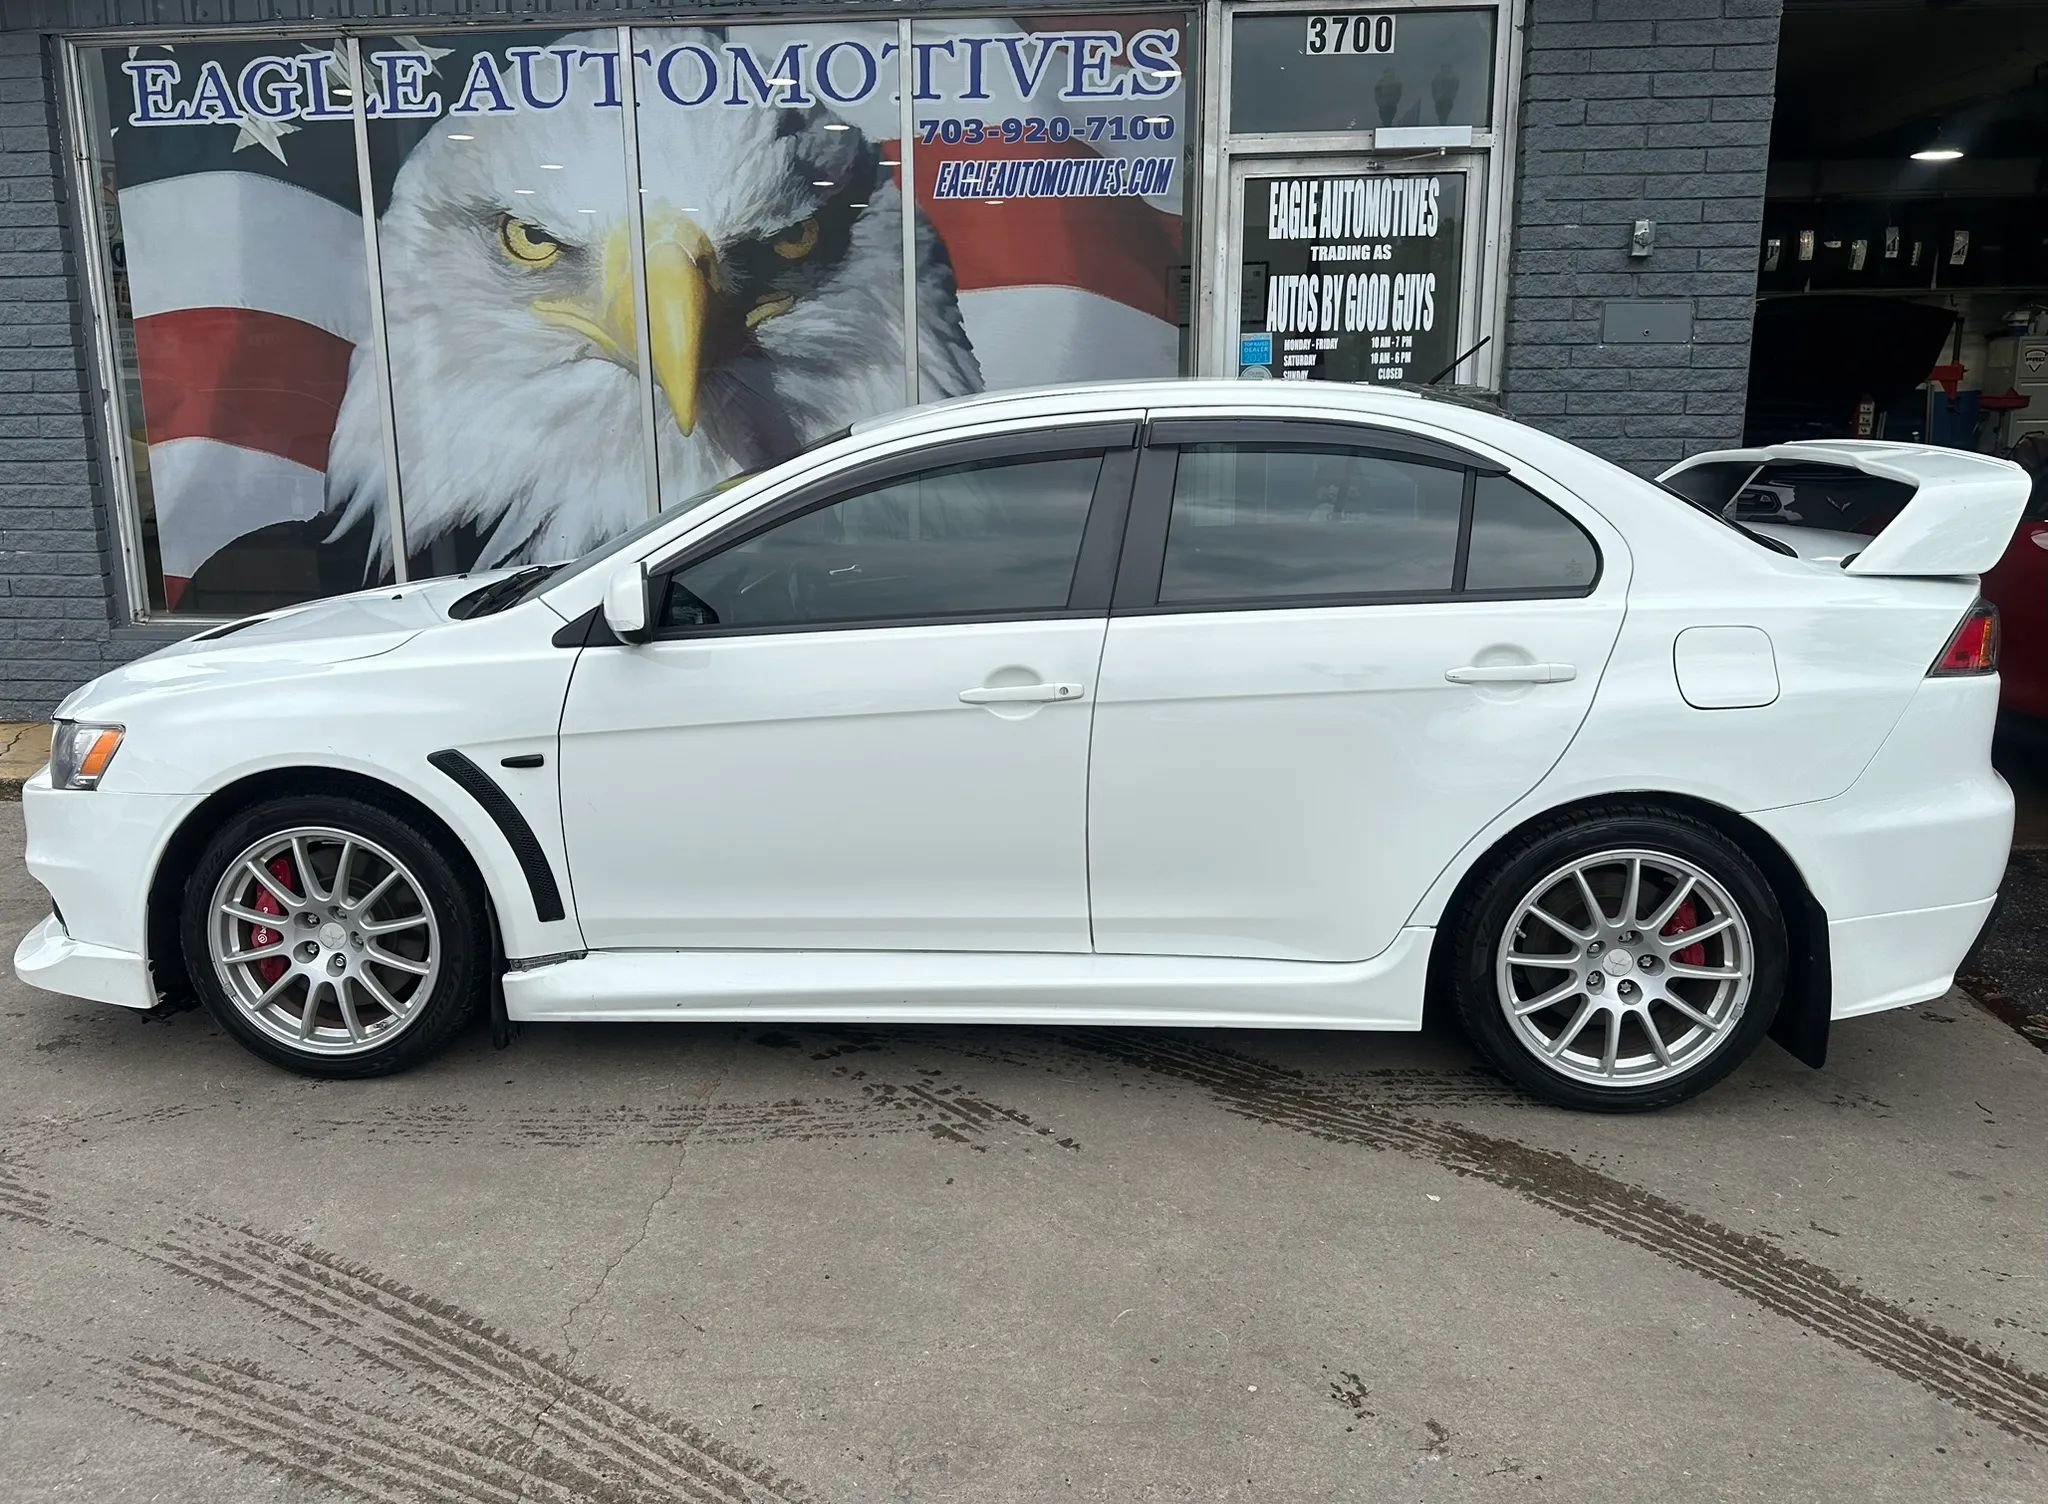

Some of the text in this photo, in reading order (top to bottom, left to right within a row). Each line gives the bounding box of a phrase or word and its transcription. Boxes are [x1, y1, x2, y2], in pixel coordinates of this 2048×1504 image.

[1309, 15, 1393, 54] 3700
[123, 31, 1181, 125] EAGLE AUTOMOTIVES
[919, 116, 1175, 144] 703-920-7100
[933, 157, 1175, 199] EAGLEAUTOMOTIVES.COM
[1268, 177, 1440, 241] EAGLE AUTOMOTIVES
[1310, 244, 1392, 261] TRADING AS
[1266, 275, 1319, 332] AUTOS
[1321, 274, 1345, 332] BY
[1344, 273, 1392, 331] GOOD
[1391, 272, 1436, 332] GUYS
[1284, 338, 1311, 351] MONDAY
[1315, 337, 1339, 350] FRIDAY
[1371, 337, 1379, 349] 10
[1379, 336, 1391, 348] AM
[1401, 335, 1413, 347] PM
[1244, 353, 1268, 363] 2021
[1283, 354, 1317, 367] SATURDAY
[1370, 353, 1379, 365] 10
[1379, 352, 1391, 364] AM
[1400, 352, 1412, 363] PM
[1283, 370, 1309, 380] SUNDAY
[1378, 368, 1403, 380] CLOSED
